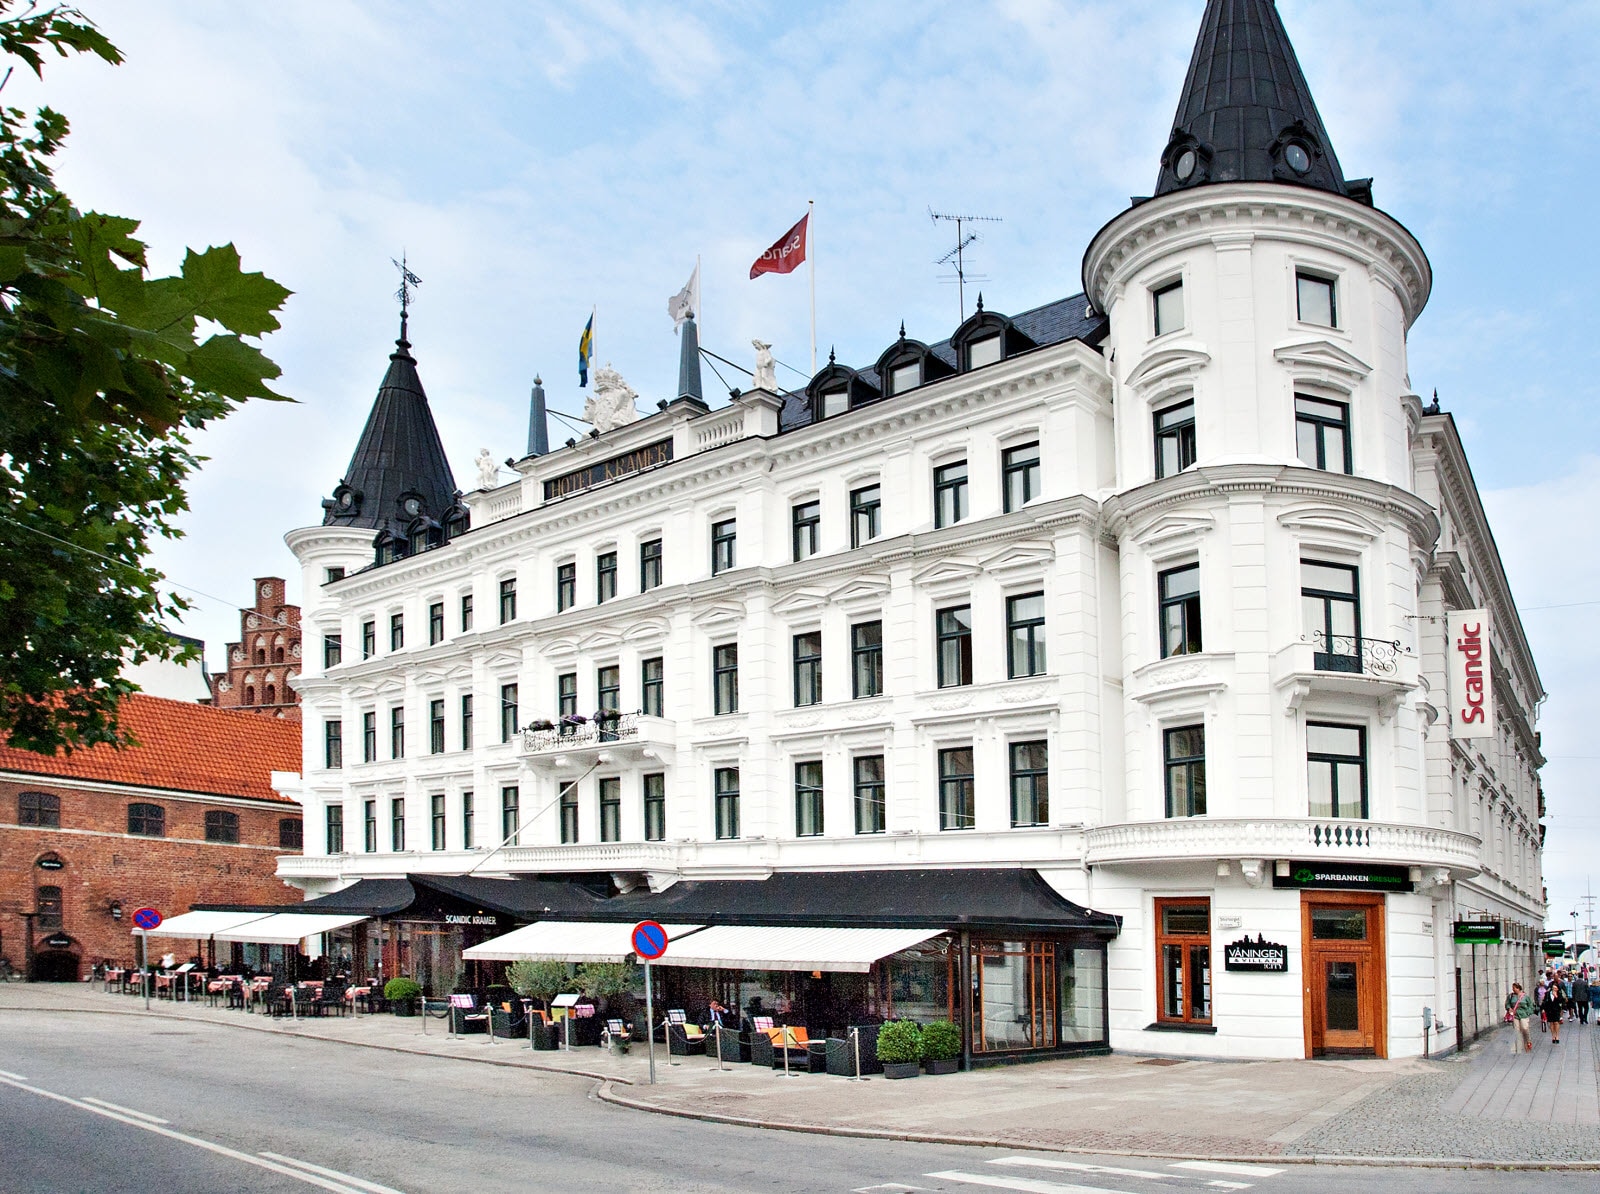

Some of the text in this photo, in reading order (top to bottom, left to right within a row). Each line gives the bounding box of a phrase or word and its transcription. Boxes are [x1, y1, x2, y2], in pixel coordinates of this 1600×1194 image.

[1457, 622, 1485, 724] Scandic
[445, 914, 497, 925] SCANDIC KRAMER
[1228, 947, 1283, 958] VÅNINGEN
